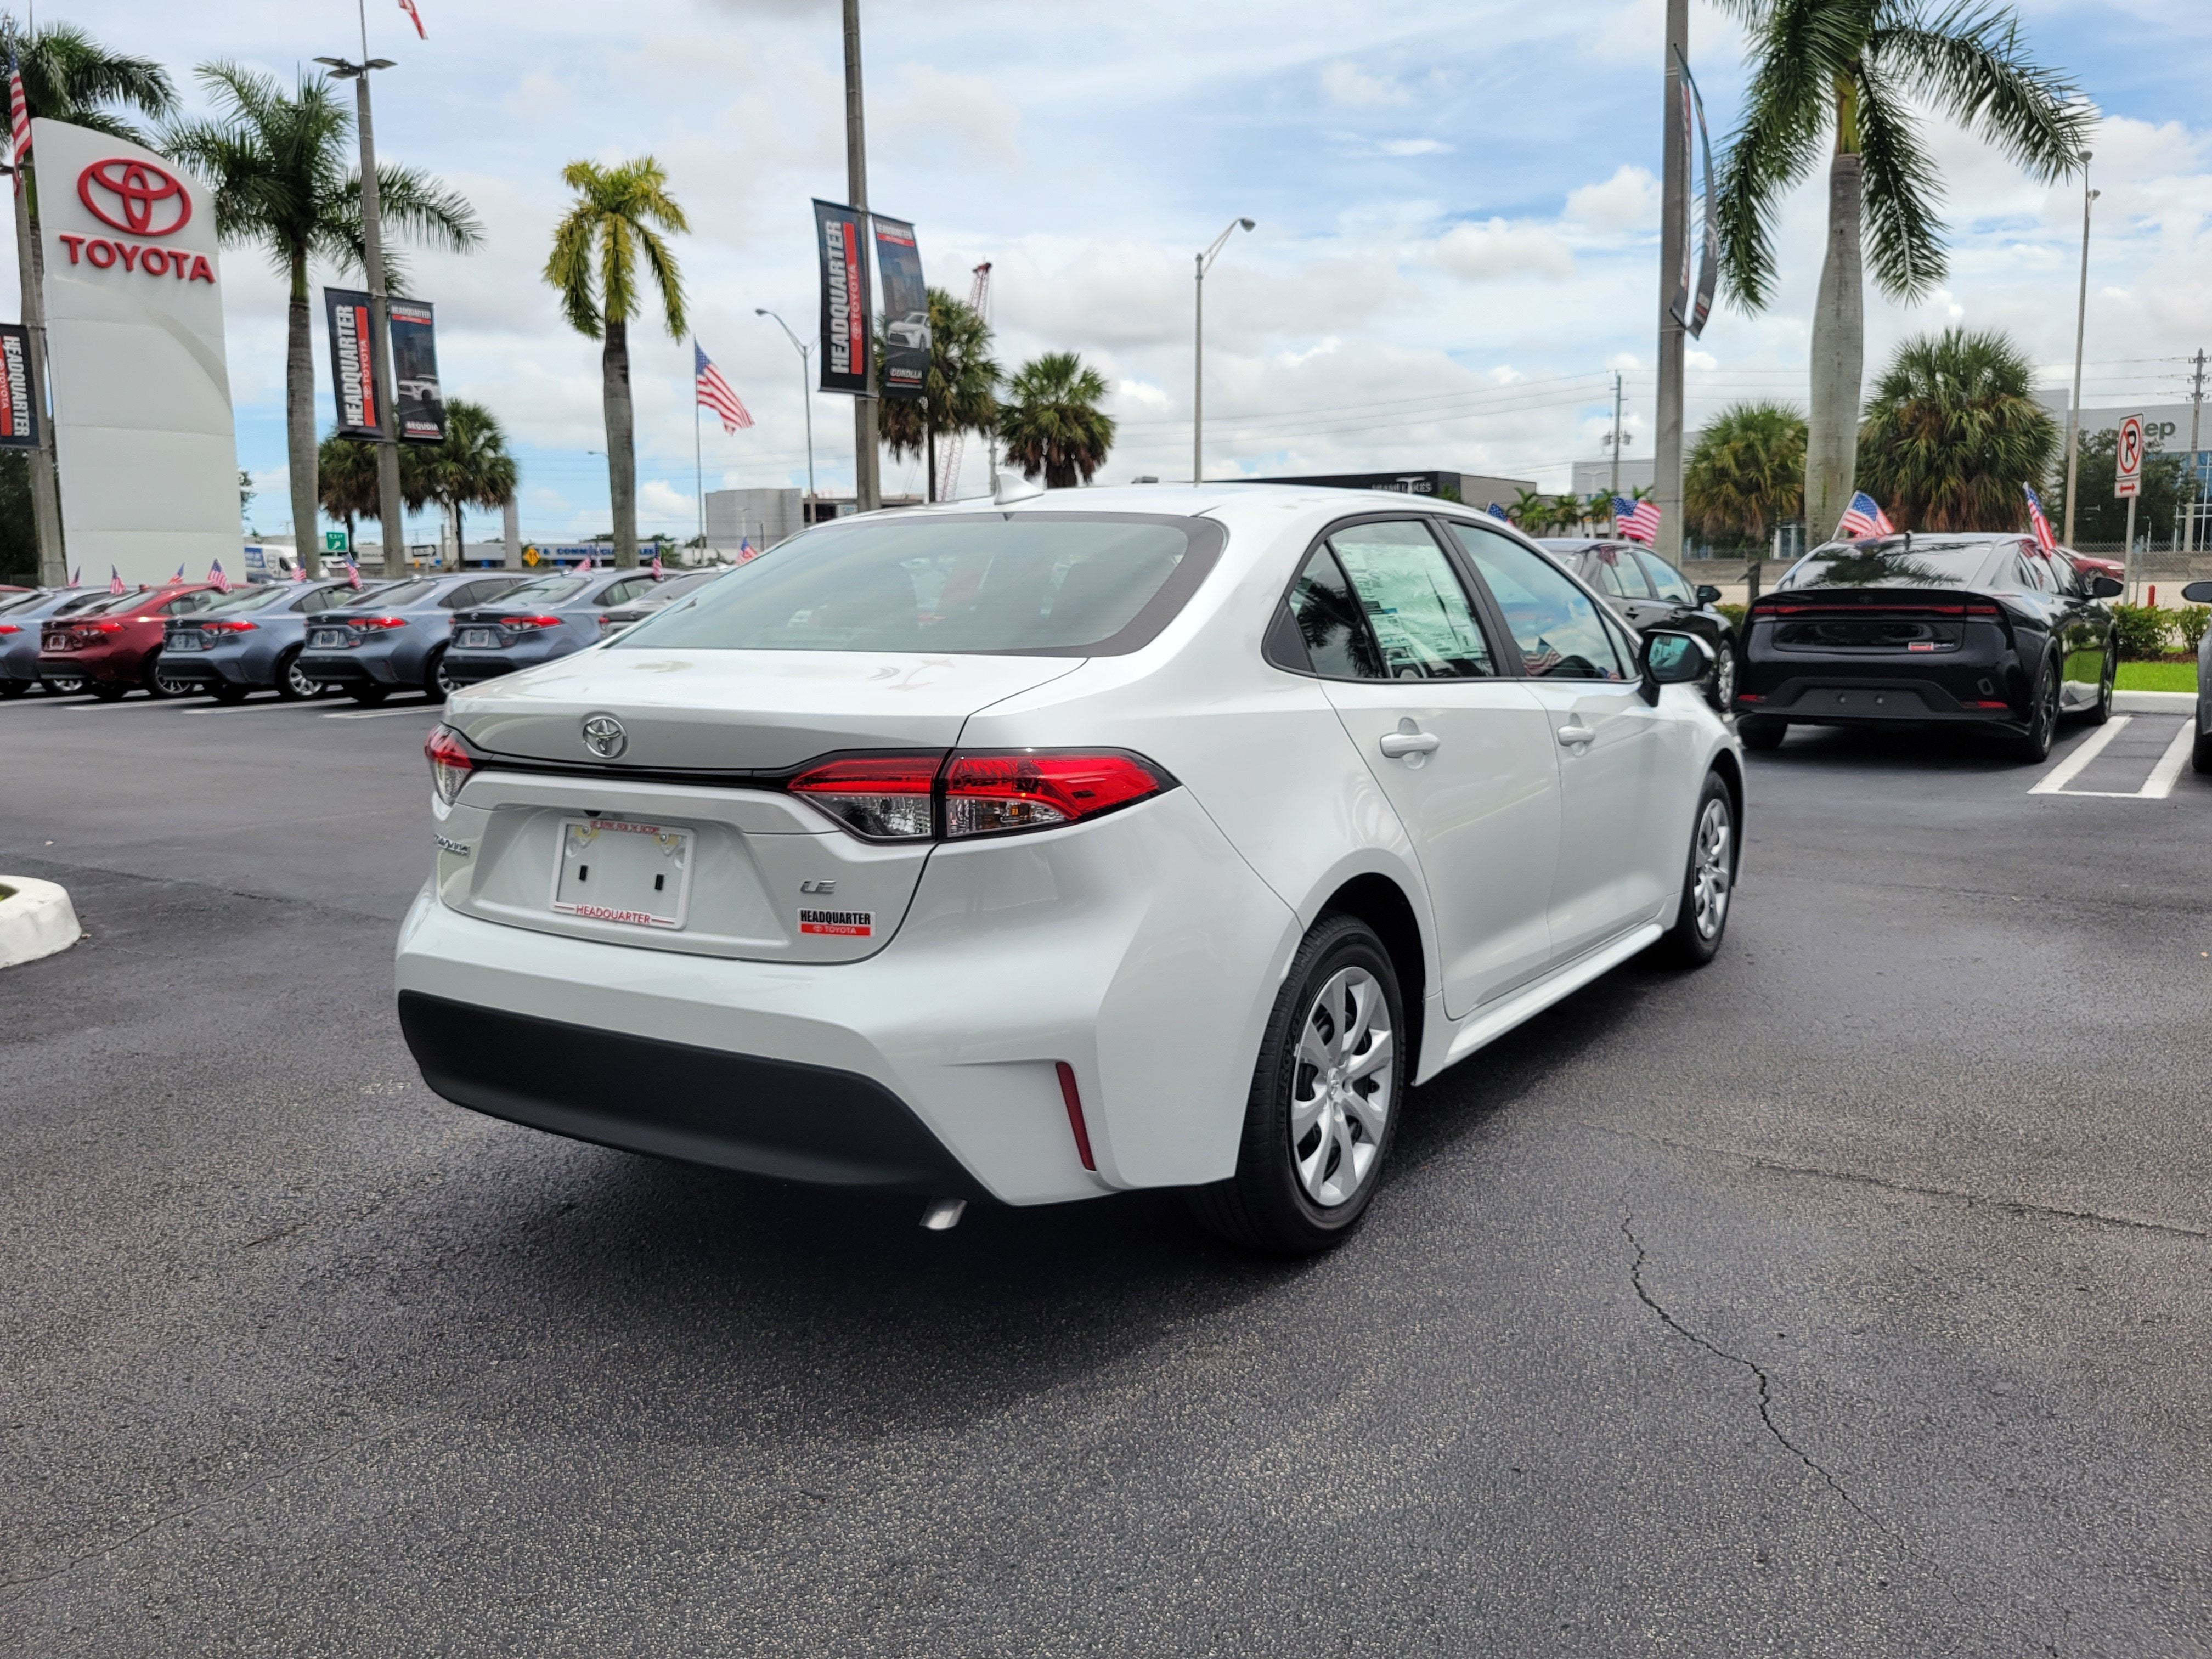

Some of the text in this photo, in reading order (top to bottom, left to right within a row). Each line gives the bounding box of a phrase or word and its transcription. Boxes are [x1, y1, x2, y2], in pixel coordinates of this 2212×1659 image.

[60, 235, 216, 283] TOYOTA
[826, 221, 850, 374] HEADQUARTER
[848, 264, 860, 320] TOYOTA
[336, 305, 364, 426] HEADQUARTER
[359, 340, 371, 383] TOYOTA
[890, 368, 922, 379] COROLLA
[3, 336, 30, 436] HEADQUARTER
[406, 421, 439, 431] SEQUOIA
[800, 879, 837, 894] LE
[577, 905, 651, 923] HEADQUARTER
[800, 910, 871, 924] HEADQUARTER
[825, 926, 856, 934] TOYOTA
